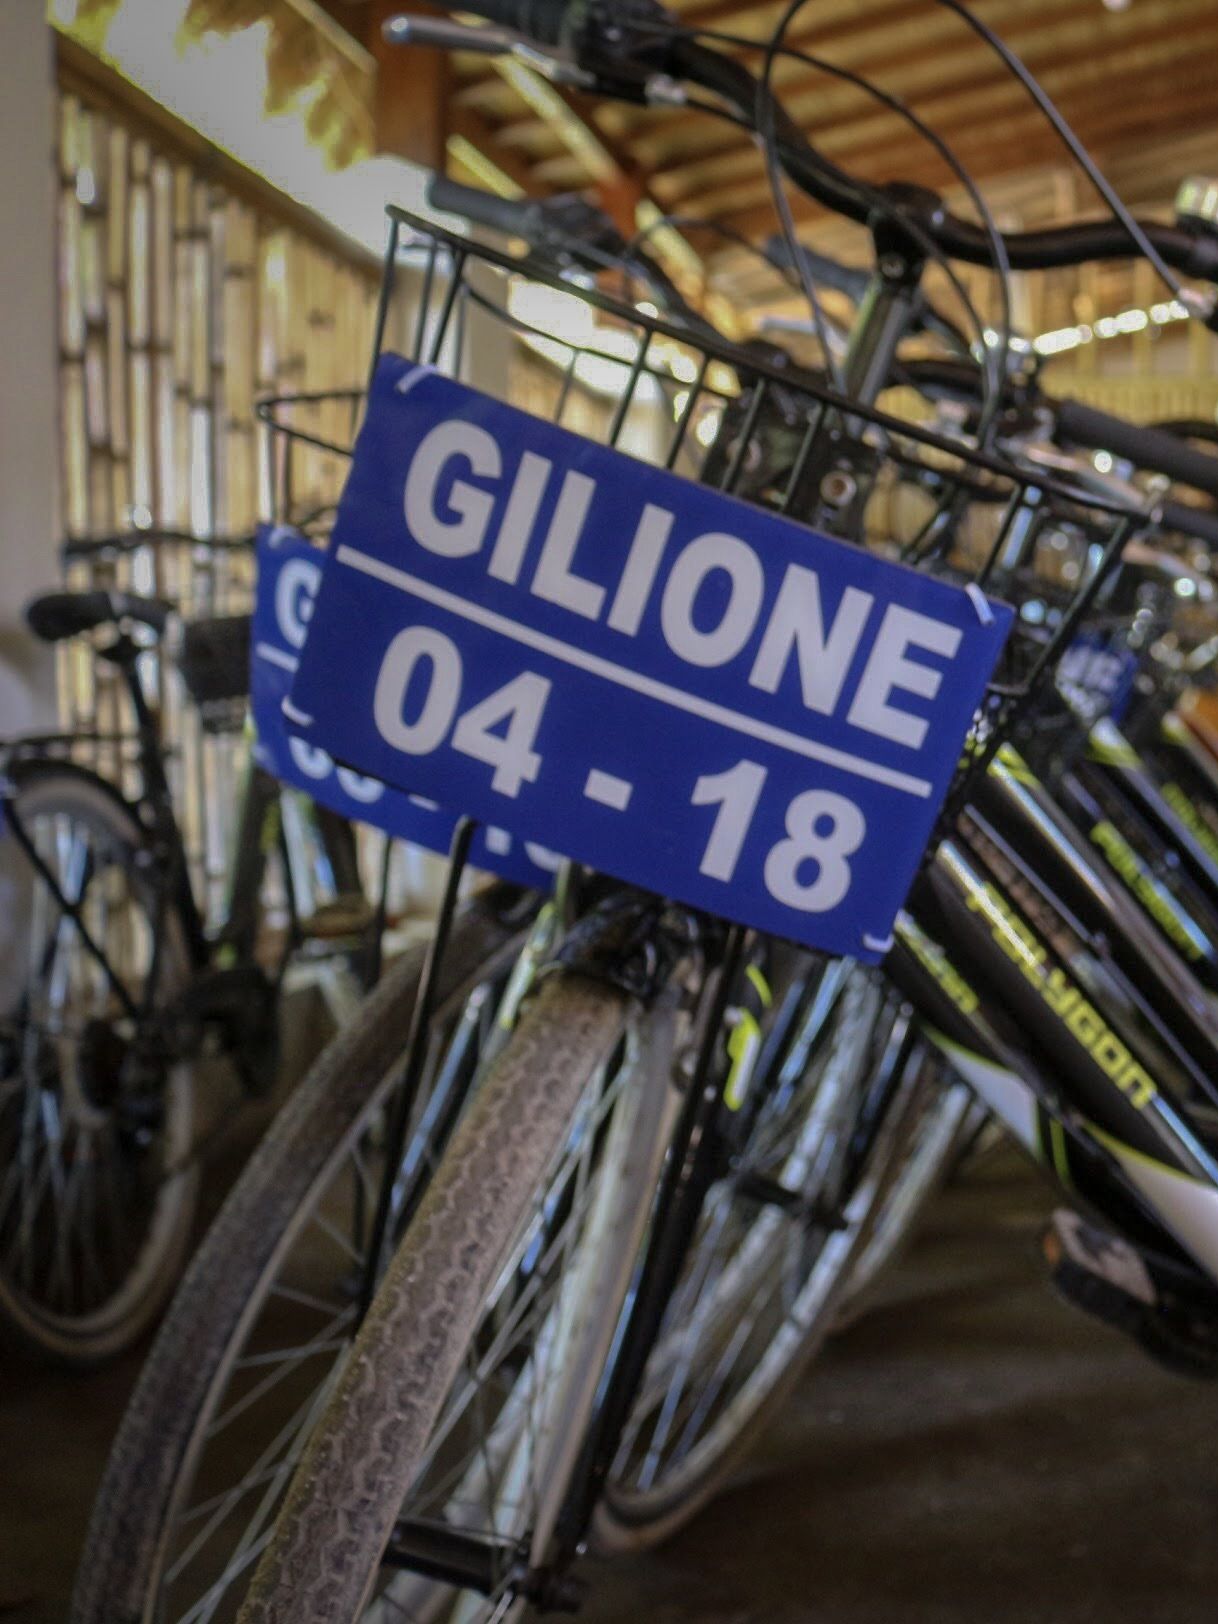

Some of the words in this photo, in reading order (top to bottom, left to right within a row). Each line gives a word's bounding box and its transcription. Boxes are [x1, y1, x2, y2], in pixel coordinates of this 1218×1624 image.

[403, 418, 963, 750] GILIONE
[373, 625, 552, 798] 04
[584, 768, 632, 811] -
[691, 759, 866, 913] 18
